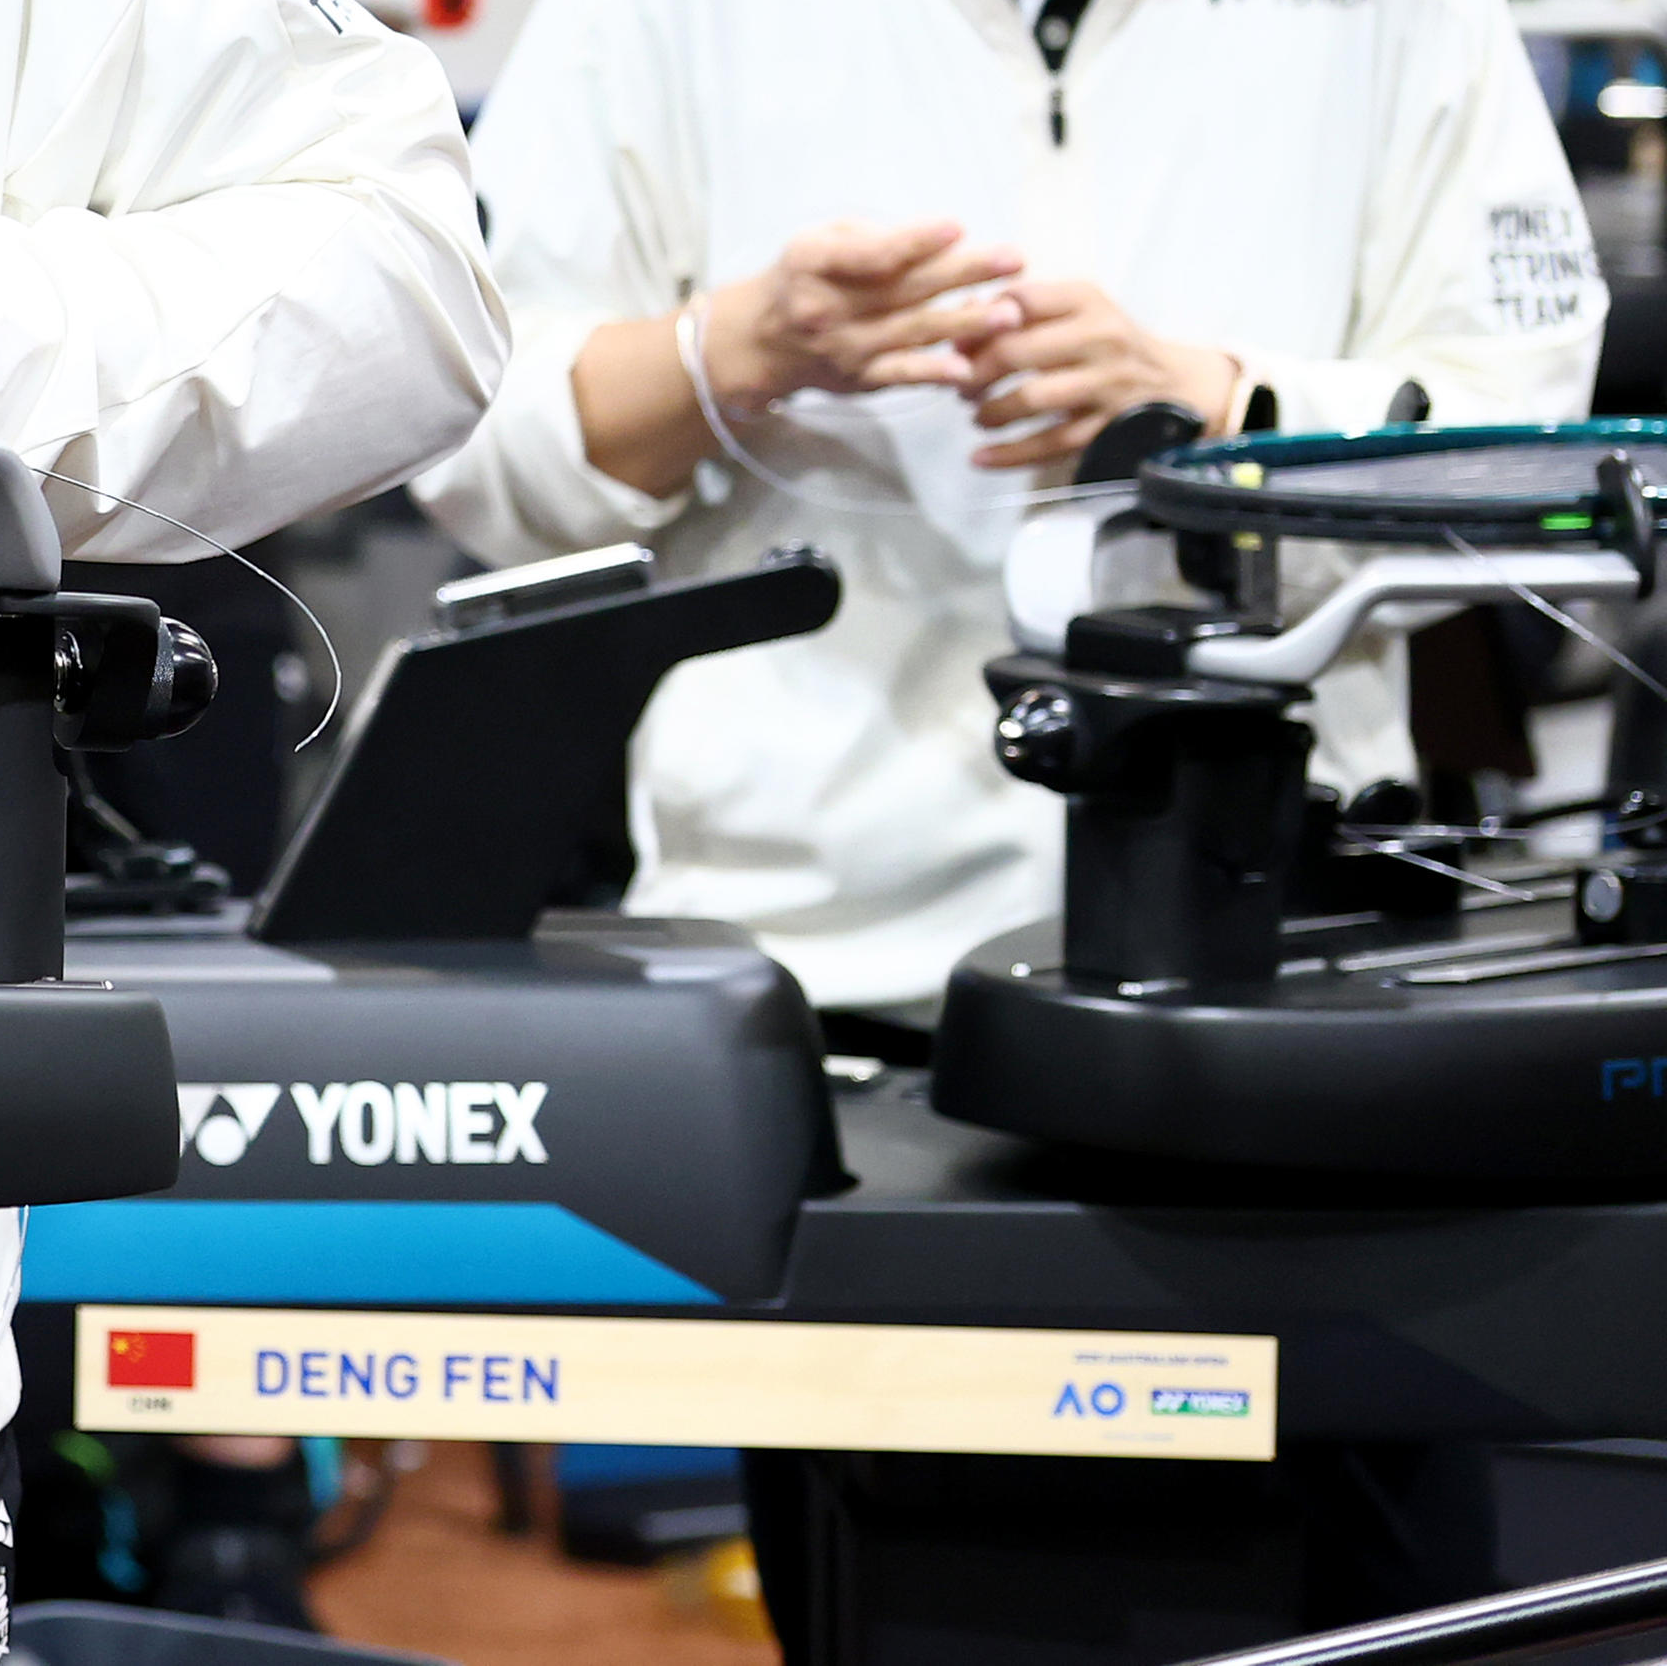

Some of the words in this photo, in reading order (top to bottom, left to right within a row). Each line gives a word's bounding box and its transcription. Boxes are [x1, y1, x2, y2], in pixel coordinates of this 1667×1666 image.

[289, 1080, 549, 1165] YONEX
[255, 1350, 420, 1399] DENG
[441, 1355, 560, 1405] FEN
